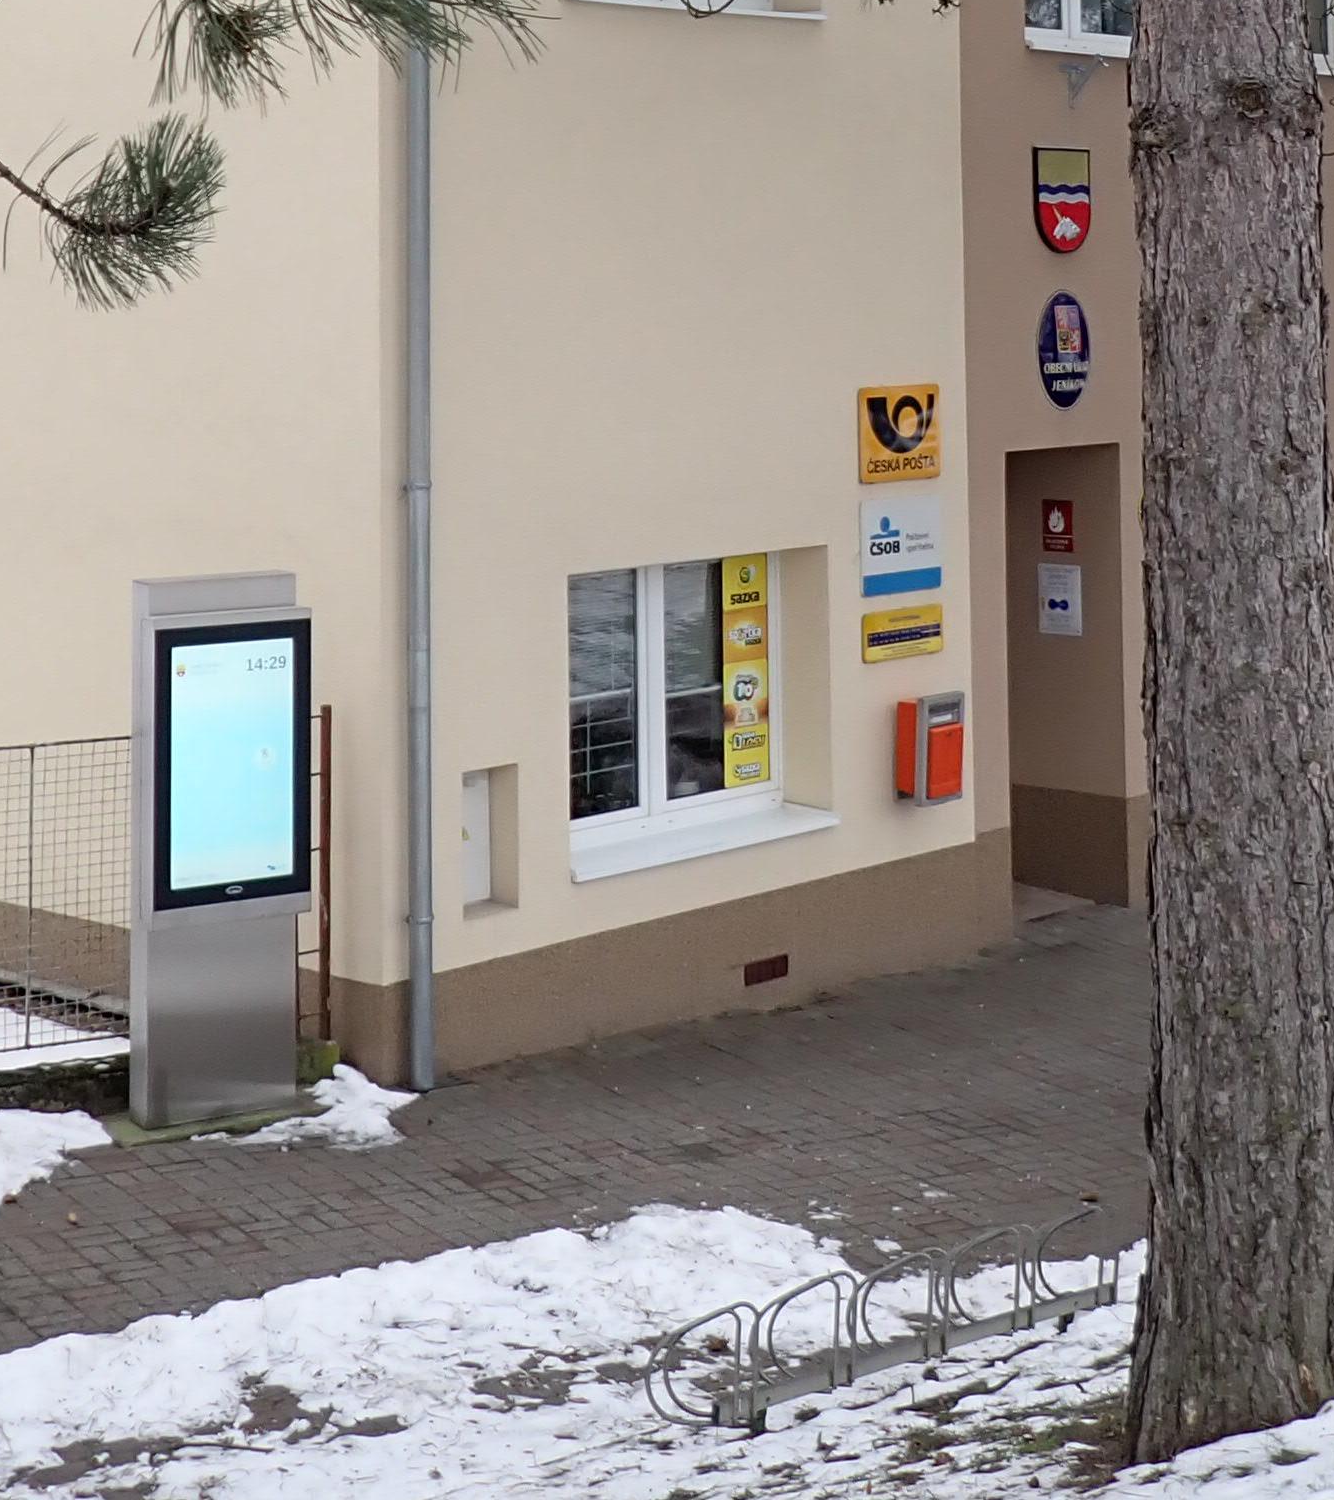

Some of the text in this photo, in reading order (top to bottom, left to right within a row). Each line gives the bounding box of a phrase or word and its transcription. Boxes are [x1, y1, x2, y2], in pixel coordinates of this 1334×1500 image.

[867, 453, 935, 474] ČESKÁ POŠTA
[870, 540, 900, 556] ČSOB
[246, 655, 287, 671] 14:29
